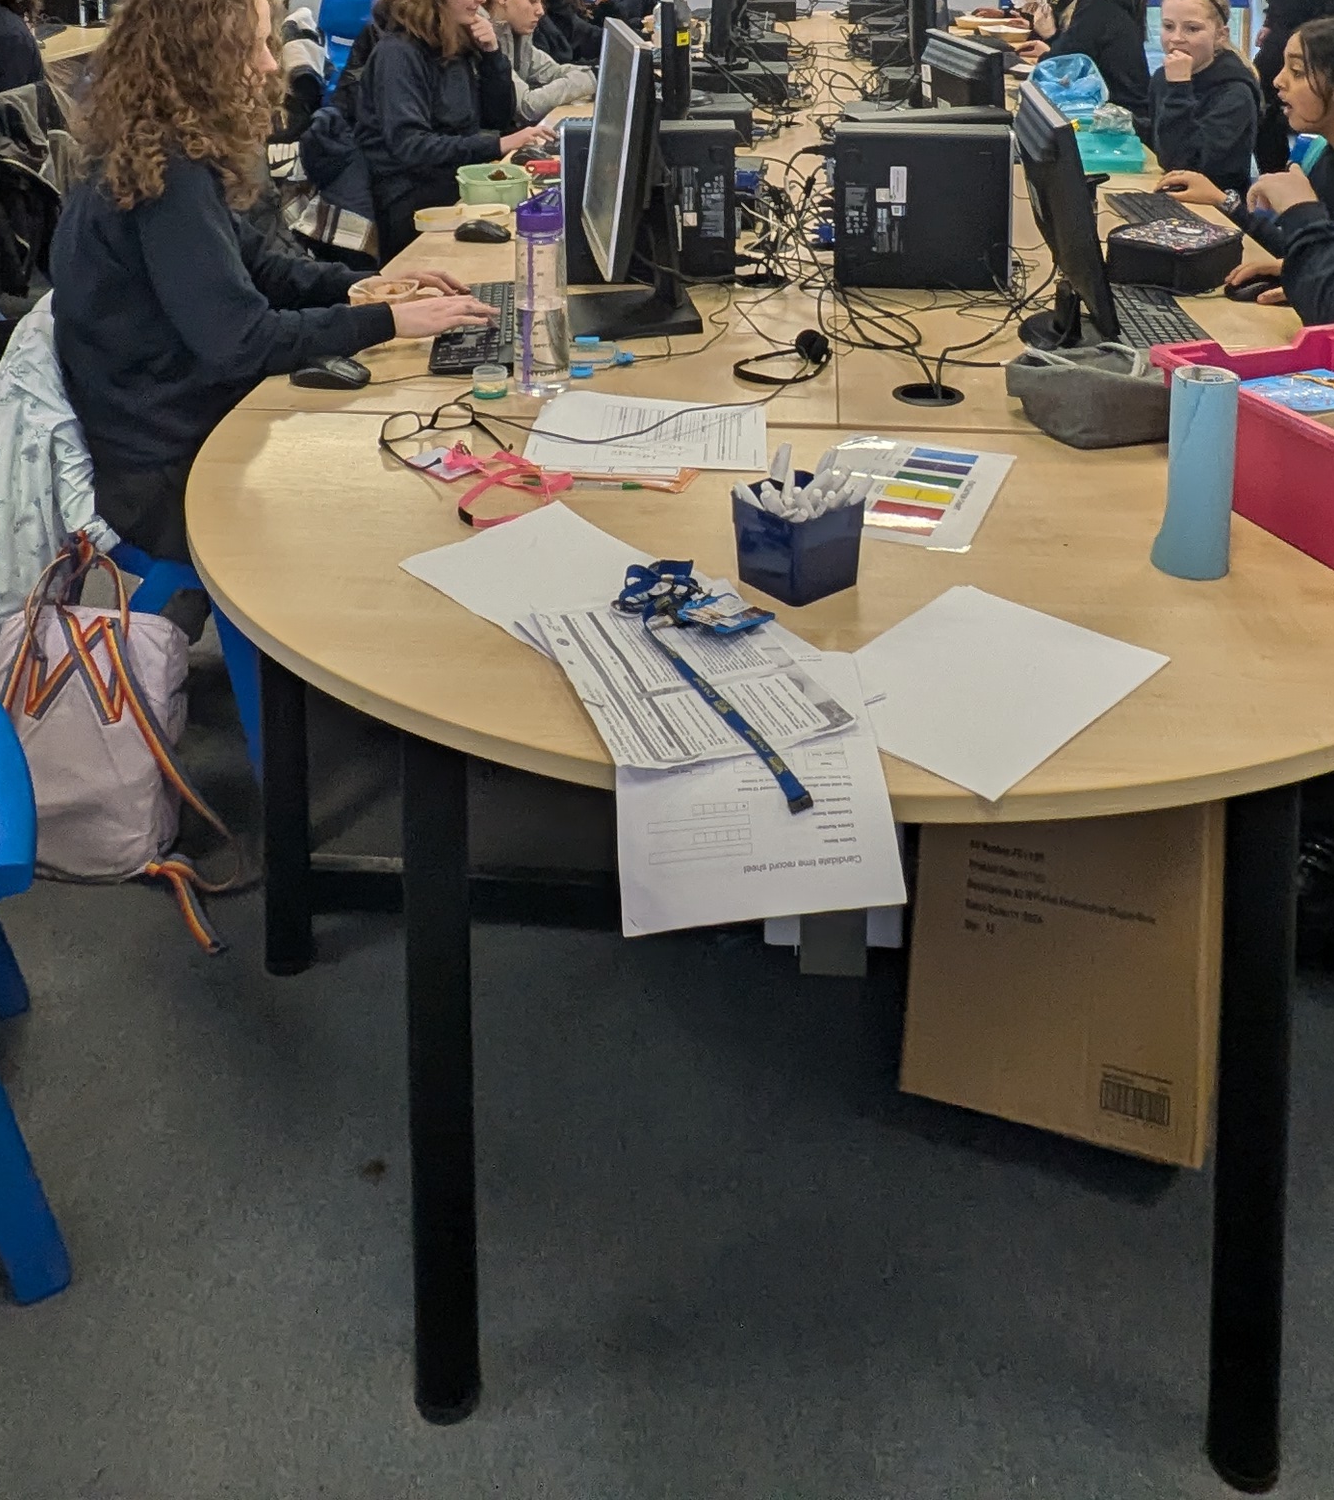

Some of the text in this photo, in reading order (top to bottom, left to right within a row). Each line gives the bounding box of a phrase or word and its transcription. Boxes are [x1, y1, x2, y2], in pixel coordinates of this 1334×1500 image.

[818, 854, 862, 865] Candidate
[743, 864, 767, 874] sheet
[769, 861, 796, 871] record
